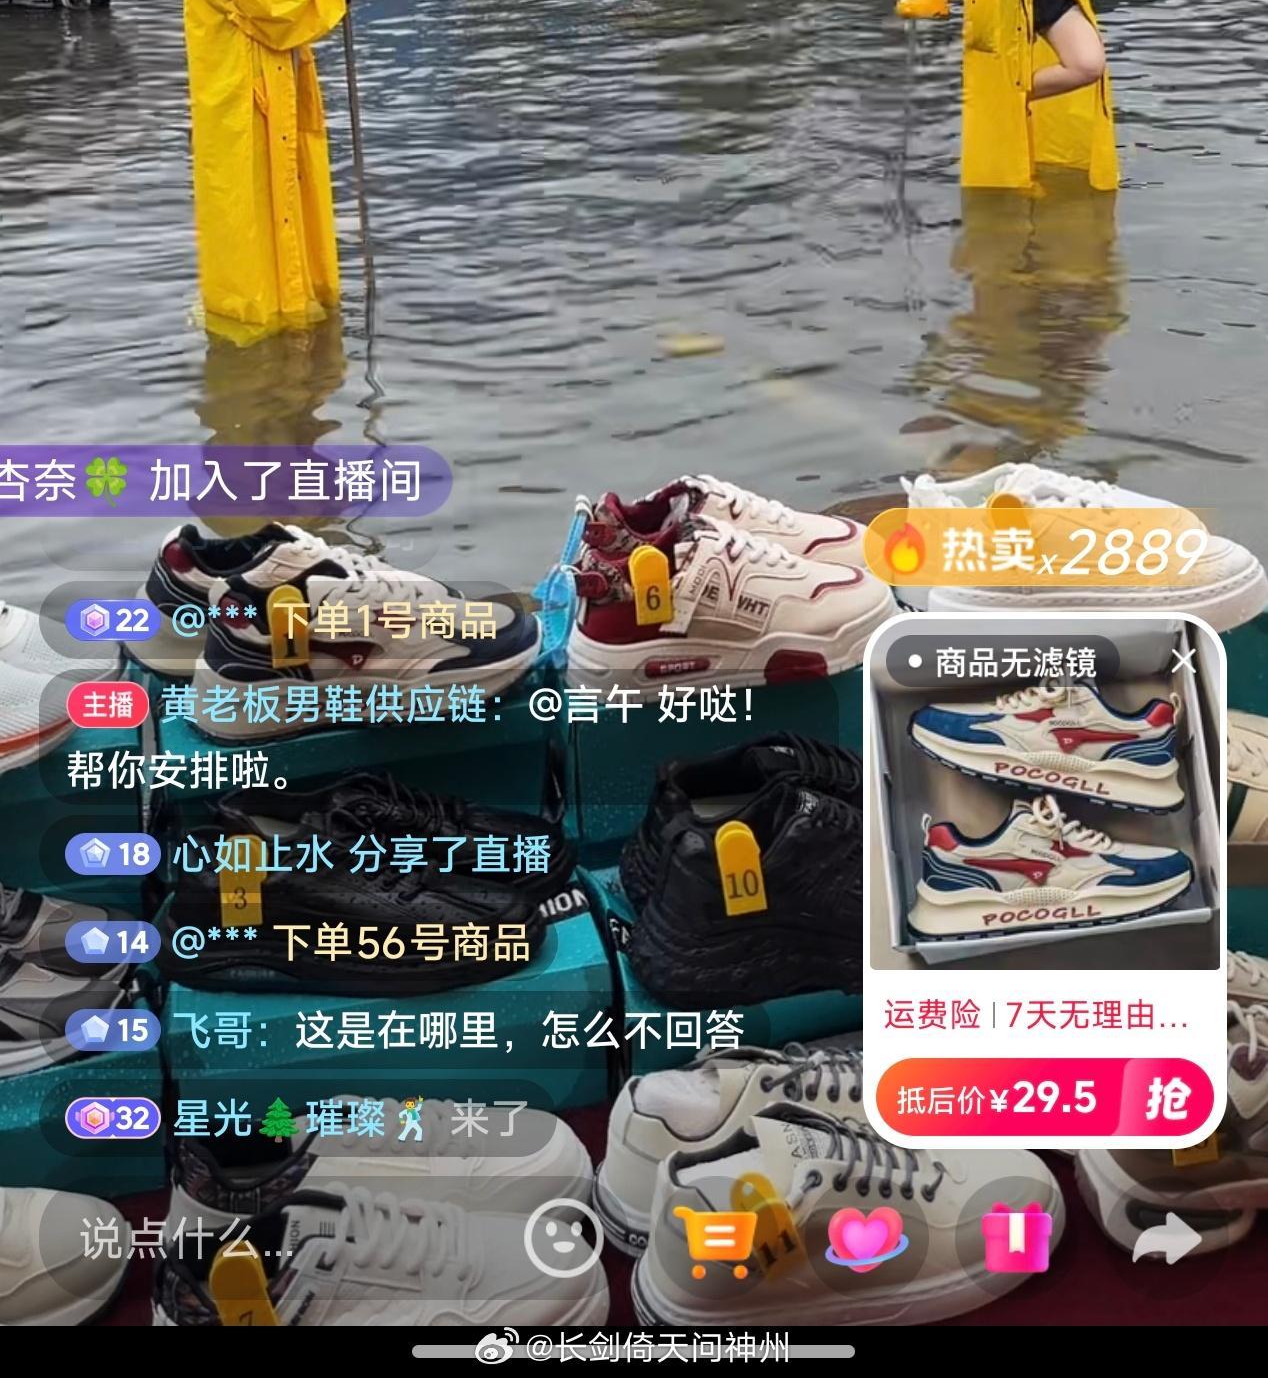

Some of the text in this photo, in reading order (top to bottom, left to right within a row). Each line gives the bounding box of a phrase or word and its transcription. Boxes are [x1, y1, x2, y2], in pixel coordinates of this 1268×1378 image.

[646, 585, 660, 611] 6
[995, 762, 1110, 795] POCOGLL
[726, 869, 759, 899] 10
[982, 904, 1101, 926] POCOGLL
